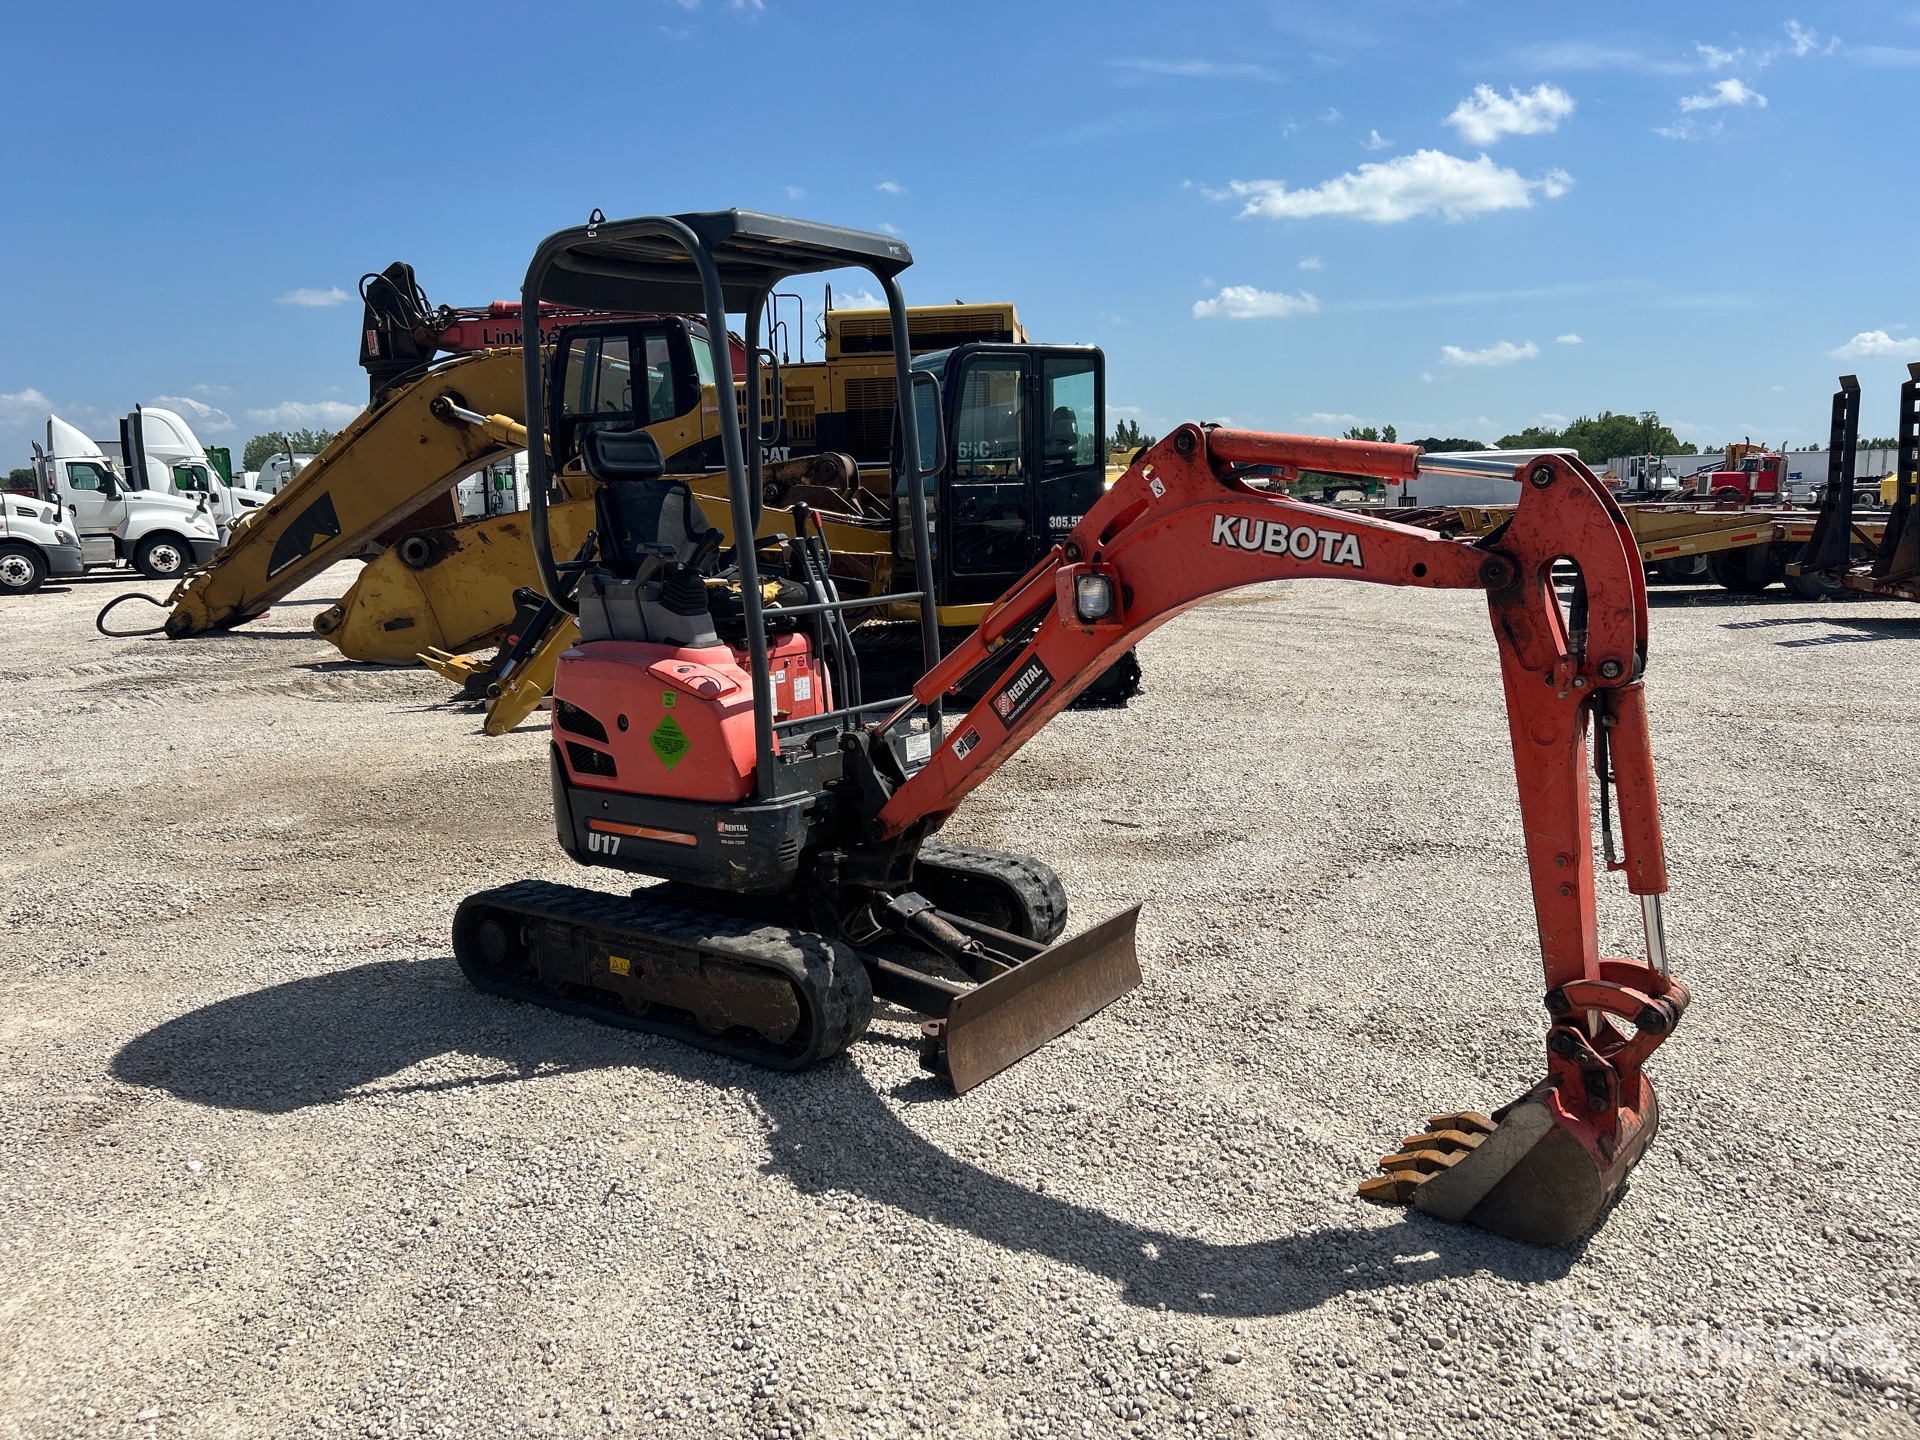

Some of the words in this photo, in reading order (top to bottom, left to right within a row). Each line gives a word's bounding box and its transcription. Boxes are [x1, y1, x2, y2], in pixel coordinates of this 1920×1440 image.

[760, 446, 791, 465] CAT
[1211, 514, 1364, 567] KUBOTA
[1007, 664, 1043, 702] RENTAL
[1008, 677, 1050, 722] homedepot.com/rental
[724, 823, 749, 832] RENTAL
[588, 832, 621, 856] U17
